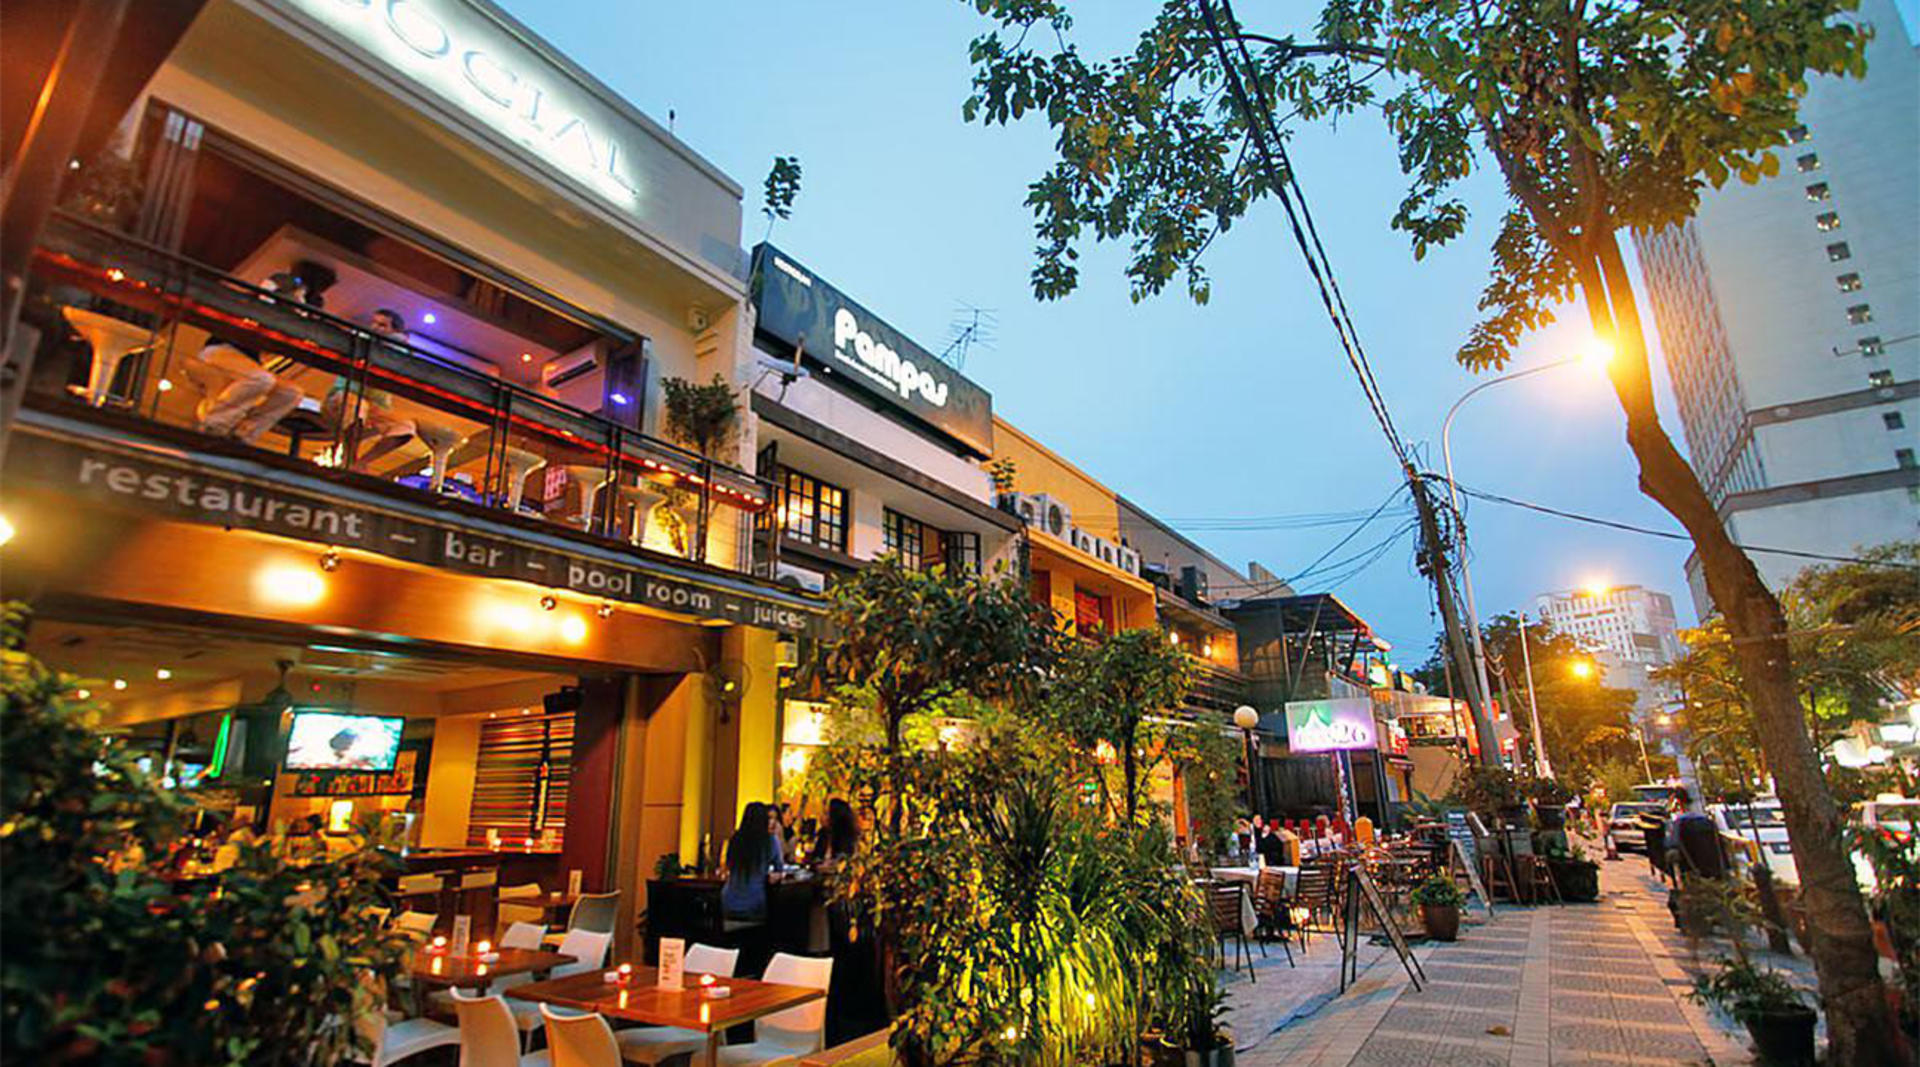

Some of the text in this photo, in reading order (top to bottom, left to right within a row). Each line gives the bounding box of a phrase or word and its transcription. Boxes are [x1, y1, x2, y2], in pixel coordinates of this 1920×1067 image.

[336, 0, 640, 197] OCIAL
[834, 307, 949, 407] Pampas
[79, 457, 364, 538] restaurant
[444, 532, 504, 569] bar
[567, 564, 632, 595] pool
[646, 582, 712, 611] room
[752, 601, 807, 630] juices
